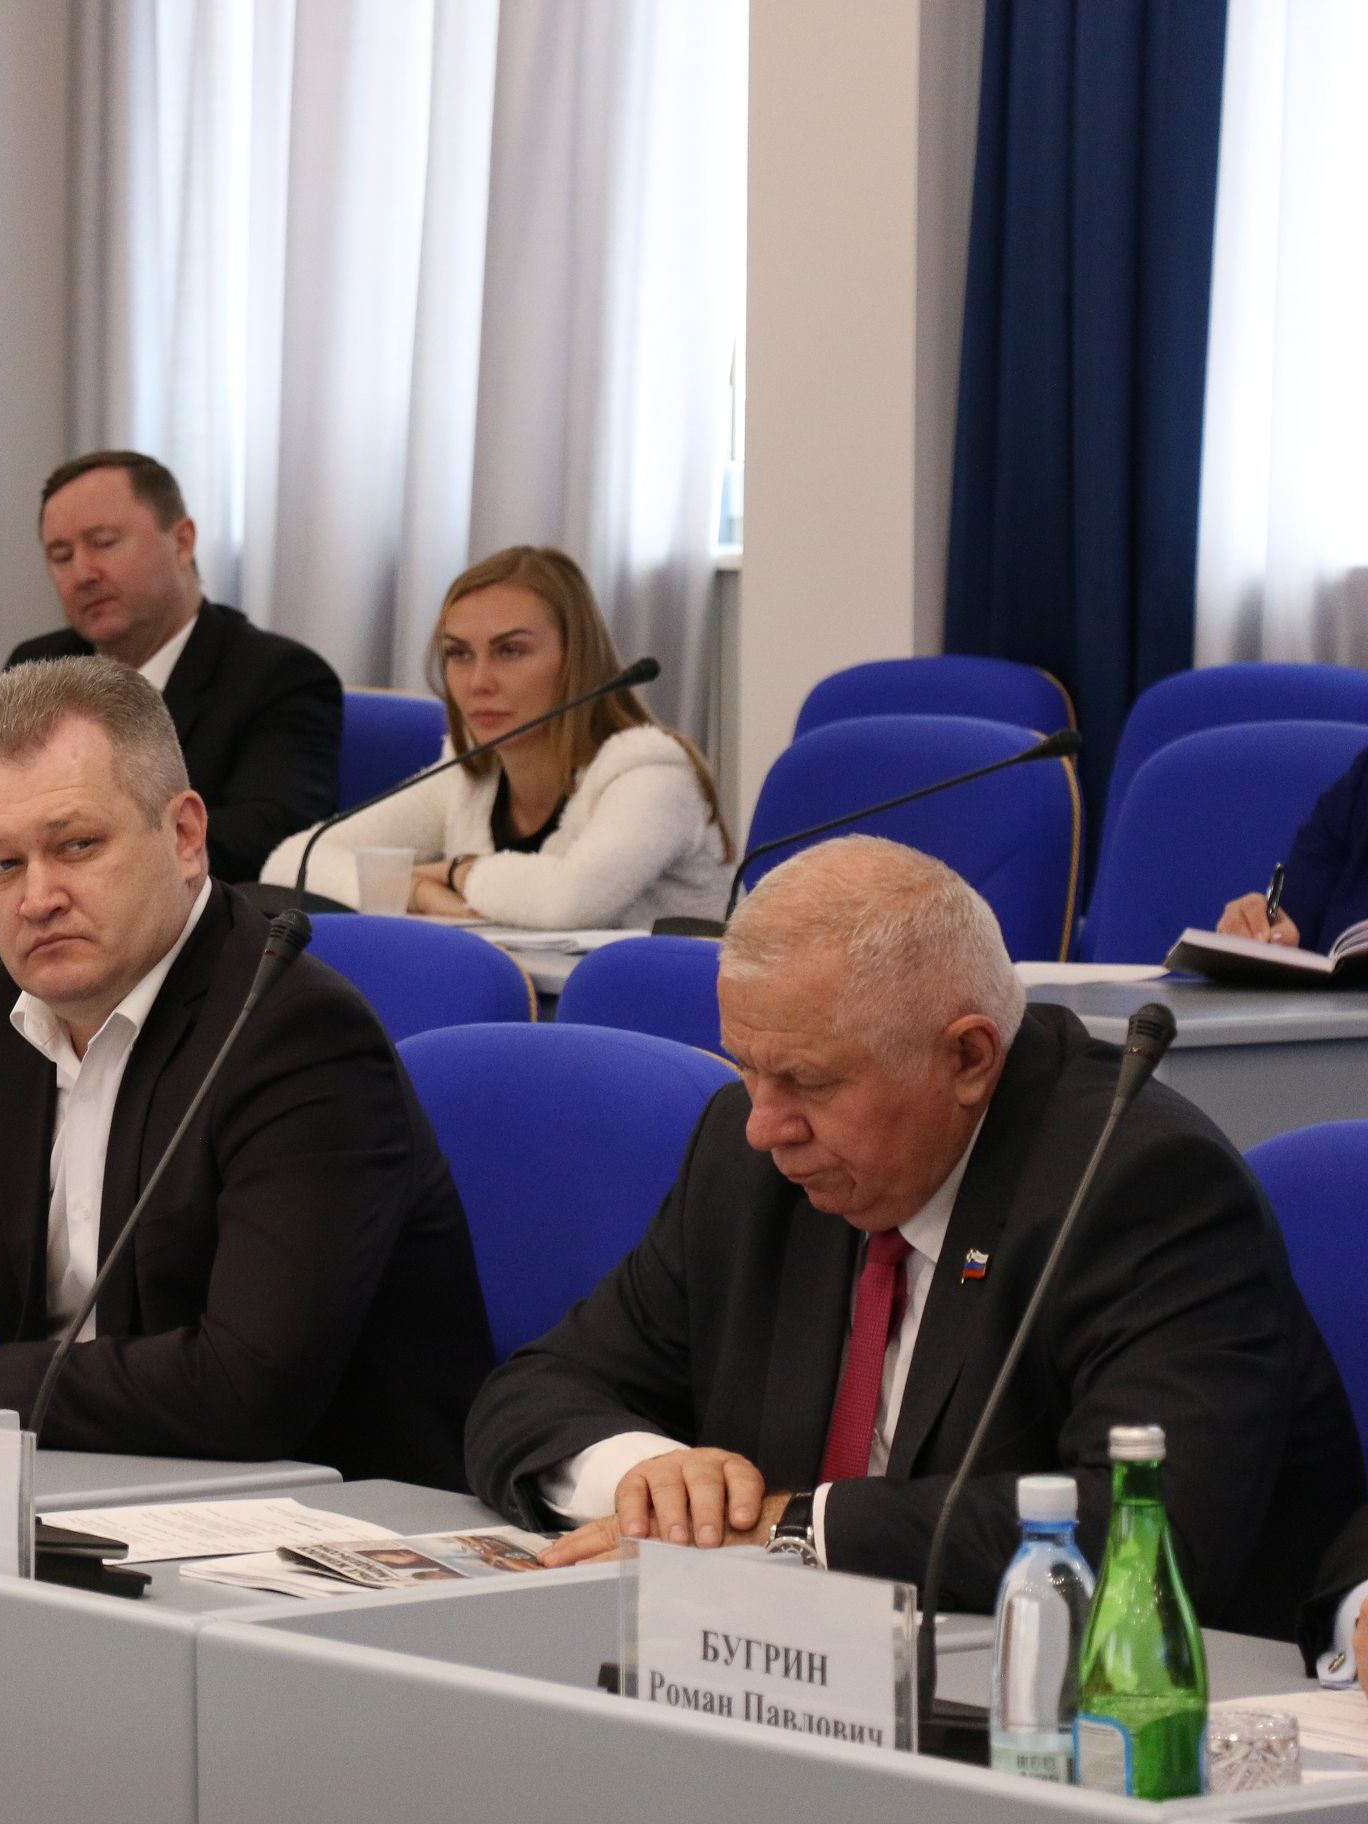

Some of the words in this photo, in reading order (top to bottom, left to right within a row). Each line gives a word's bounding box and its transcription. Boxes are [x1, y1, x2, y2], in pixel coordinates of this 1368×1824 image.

[700, 1629, 829, 1687] БУГРИН
[648, 1669, 735, 1719] Роман
[743, 1690, 884, 1748] Павлович
